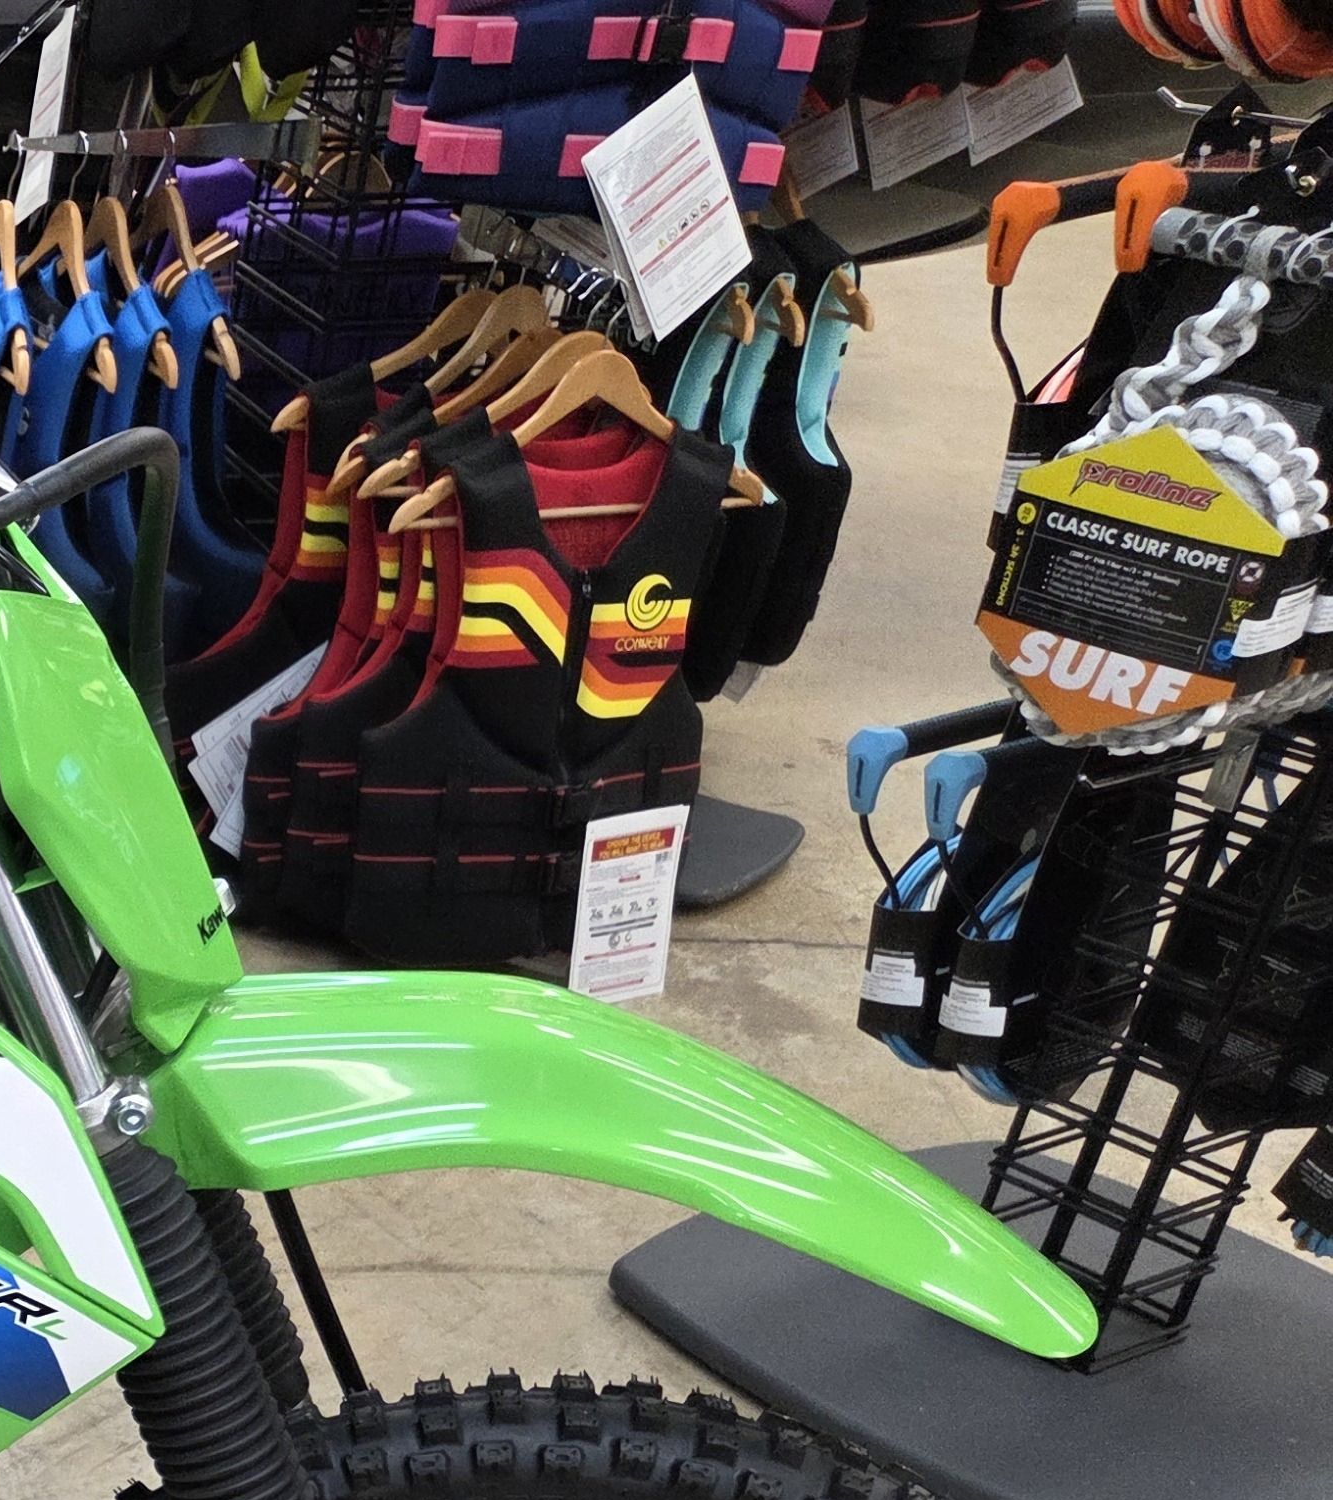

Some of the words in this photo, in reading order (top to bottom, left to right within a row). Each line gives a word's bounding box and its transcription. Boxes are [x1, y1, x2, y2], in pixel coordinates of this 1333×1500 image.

[1046, 512, 1118, 546] CLASSIC
[1120, 532, 1172, 559] SURF
[1174, 546, 1231, 573] ROPE
[995, 559, 1016, 607] SECTIONS
[1009, 630, 1194, 715] SURF
[197, 902, 227, 946] Kaw
